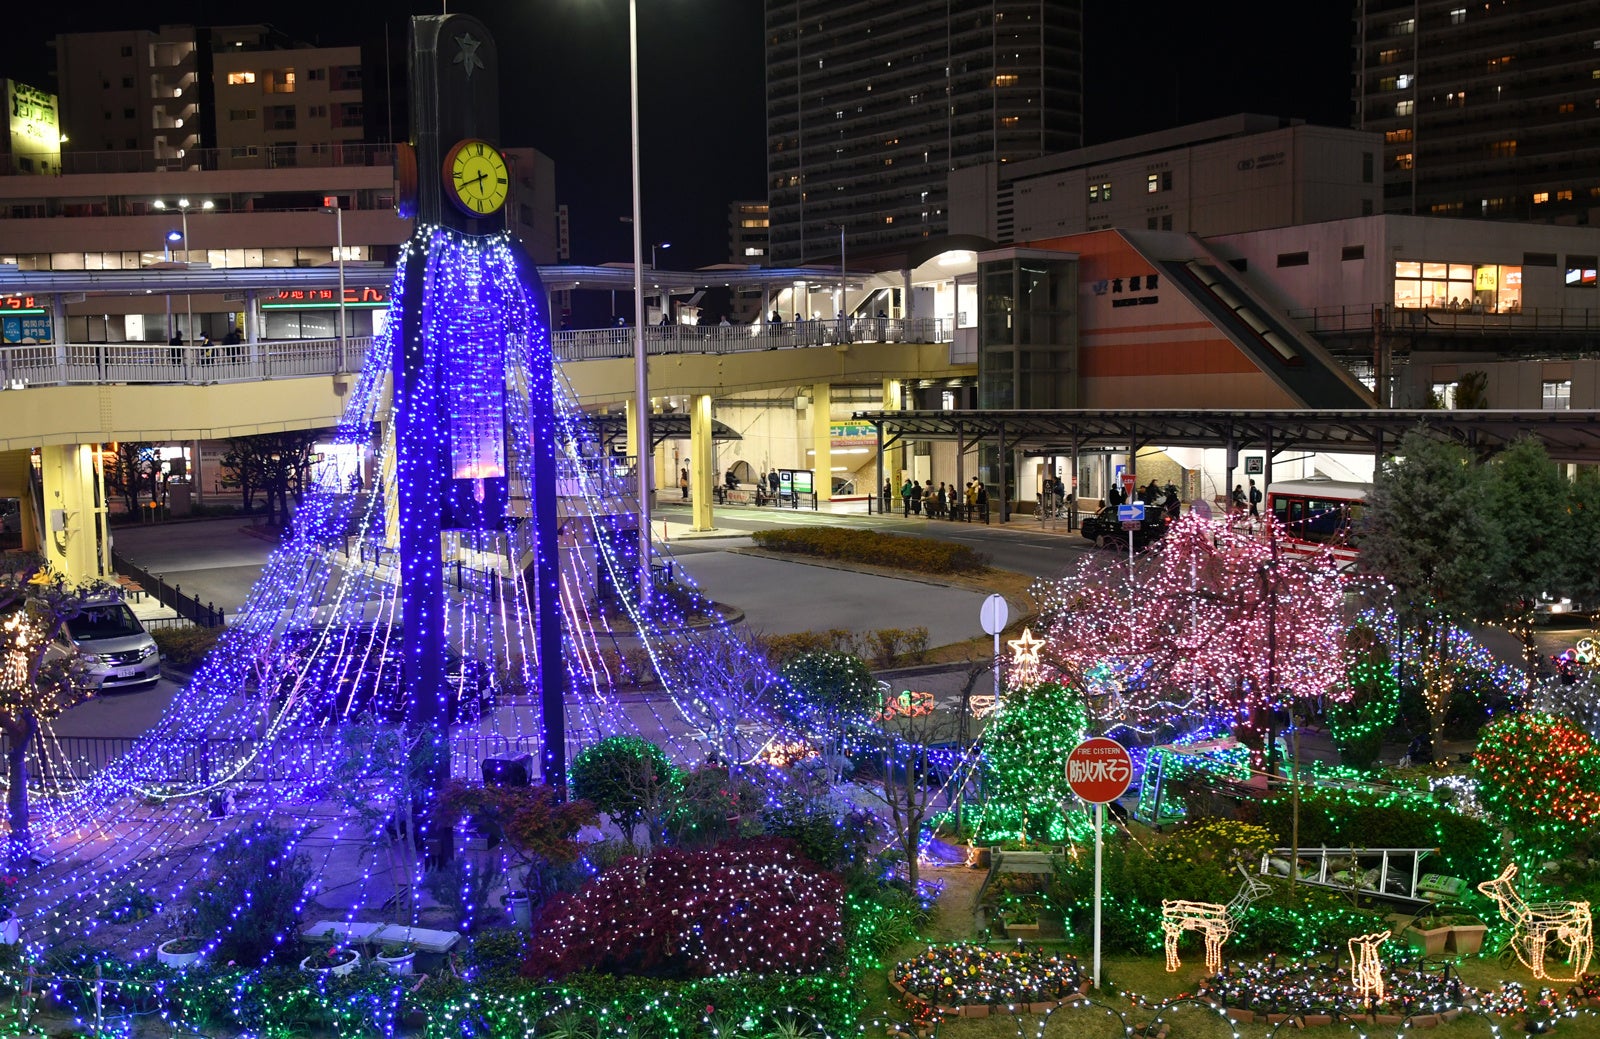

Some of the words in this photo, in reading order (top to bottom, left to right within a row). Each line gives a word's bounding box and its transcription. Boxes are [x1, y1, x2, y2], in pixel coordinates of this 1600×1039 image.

[1093, 747, 1121, 755] CISTERN
[1069, 758, 1130, 783] 防火水そう
